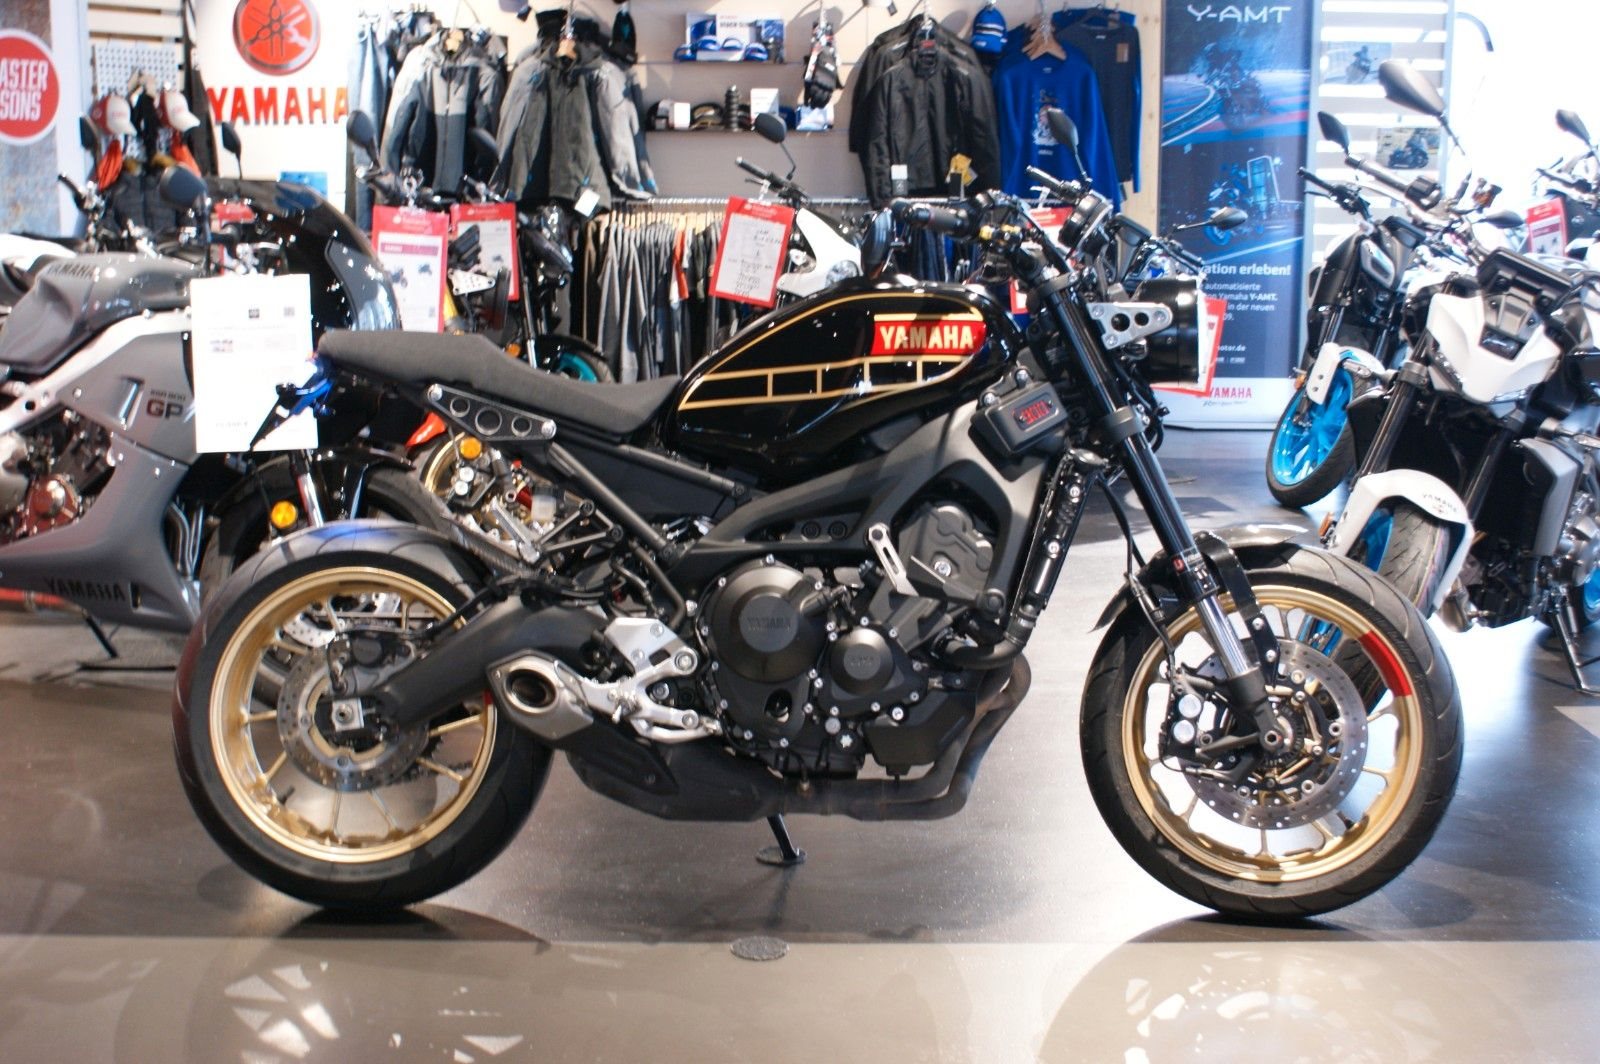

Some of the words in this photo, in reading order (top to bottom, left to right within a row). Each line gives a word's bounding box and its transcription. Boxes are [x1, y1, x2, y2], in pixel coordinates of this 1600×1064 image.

[1187, 4, 1292, 23] Y-AMT
[0, 90, 42, 121] SONS
[206, 86, 349, 125] YAMAHA
[1239, 264, 1291, 276] erleben!
[1205, 282, 1261, 291] automatisierte
[1236, 302, 1249, 311] der
[1250, 304, 1275, 312] neuen
[1249, 293, 1279, 302] Y-AMT.
[880, 324, 974, 350] YAMAHA
[146, 398, 184, 420] GP
[43, 575, 126, 602] YAMAHA
